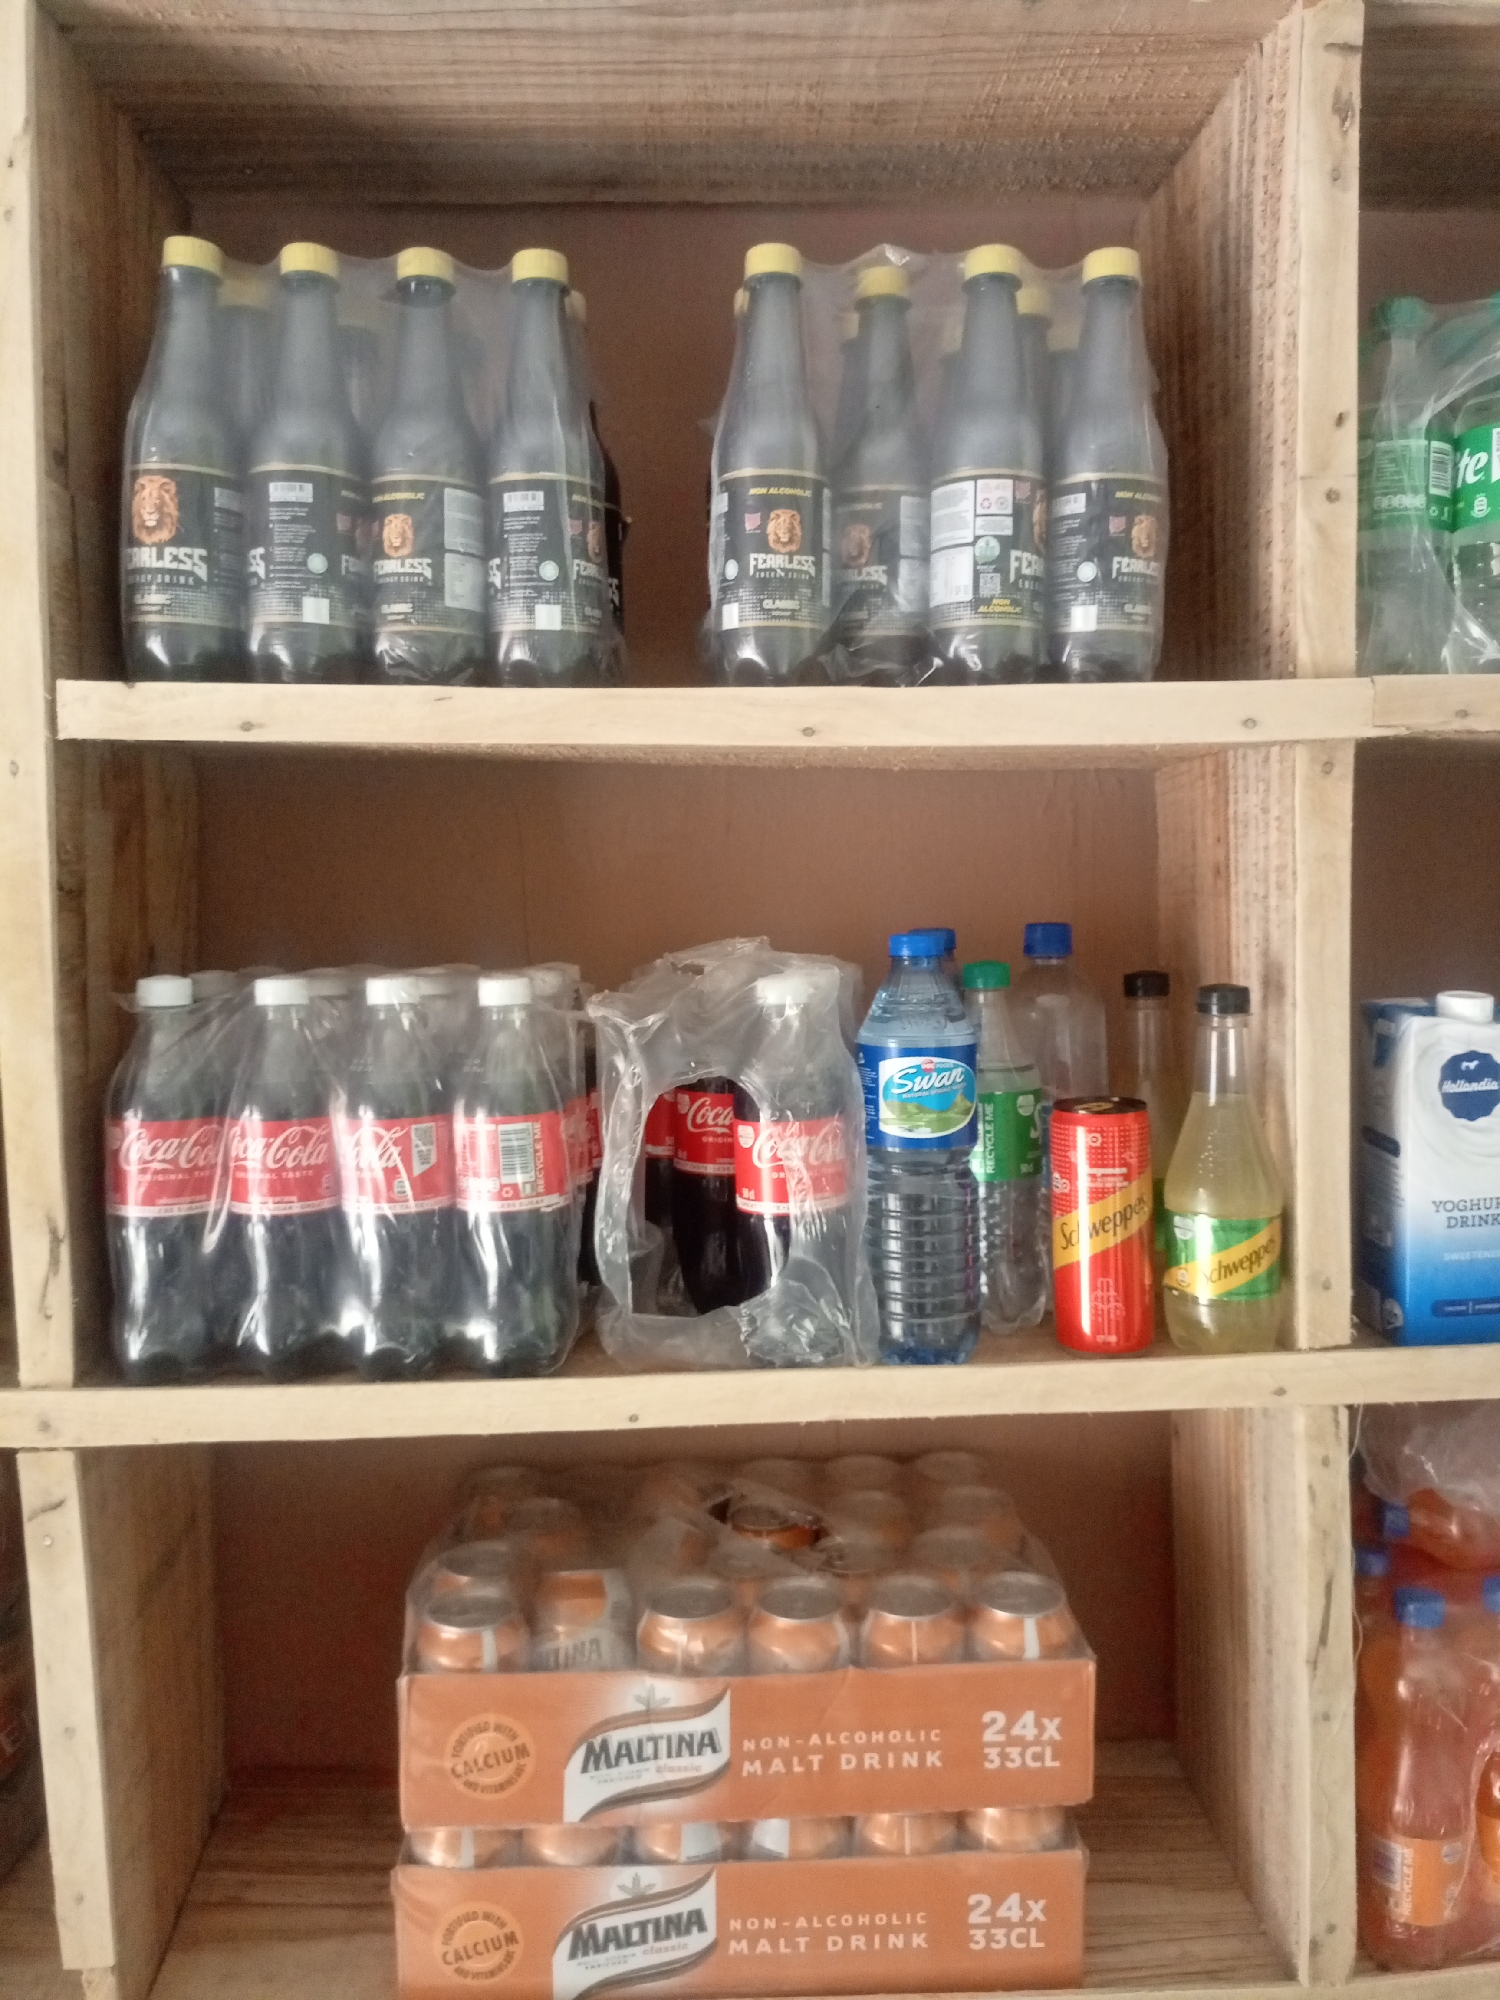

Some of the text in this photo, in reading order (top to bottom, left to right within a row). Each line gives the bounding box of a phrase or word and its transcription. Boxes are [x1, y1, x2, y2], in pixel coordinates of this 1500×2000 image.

[749, 552, 816, 577] FEARLESS
[891, 1067, 965, 1095] Swan
[1442, 1079, 1500, 1093] Hollandia
[984, 1103, 996, 1174] RECYCLE ME
[1446, 1213, 1500, 1230] DRINK
[982, 1710, 1063, 1742] 24x
[580, 1727, 724, 1775] MALTINA
[742, 1728, 942, 1753] NON-ALCOHOLIC
[450, 1742, 531, 1779] CALCIUM
[741, 1749, 944, 1777] MALT DRINK
[983, 1746, 1061, 1770] 33CL
[728, 1911, 928, 1931] NON-ALCOHOLIC
[967, 1892, 1048, 1925] 24x
[441, 1931, 520, 1966] CALCIUM
[567, 1908, 709, 1961] MALTINA
[728, 1932, 929, 1956] MALT DRINK
[969, 1927, 1046, 1951] 33CL
